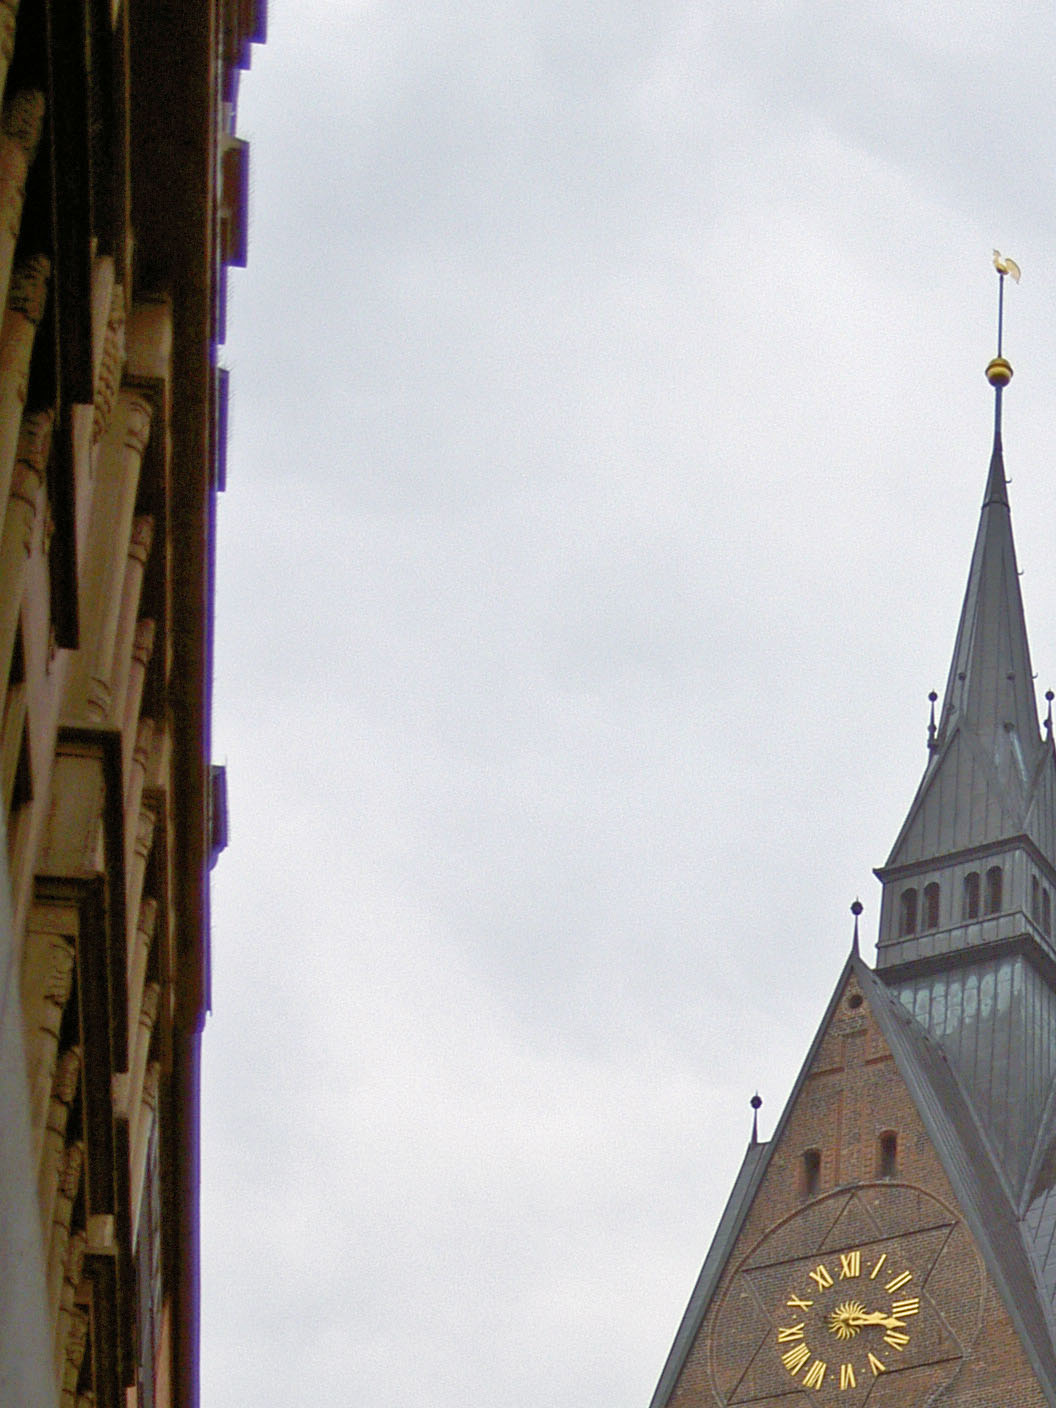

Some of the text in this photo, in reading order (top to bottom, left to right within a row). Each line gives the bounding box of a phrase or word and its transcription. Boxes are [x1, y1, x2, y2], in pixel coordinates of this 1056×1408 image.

[809, 1264, 834, 1292] XI
[839, 1251, 860, 1280] XII
[884, 1270, 912, 1294] II
[892, 1298, 919, 1318] III
[840, 1363, 856, 1390] VI
